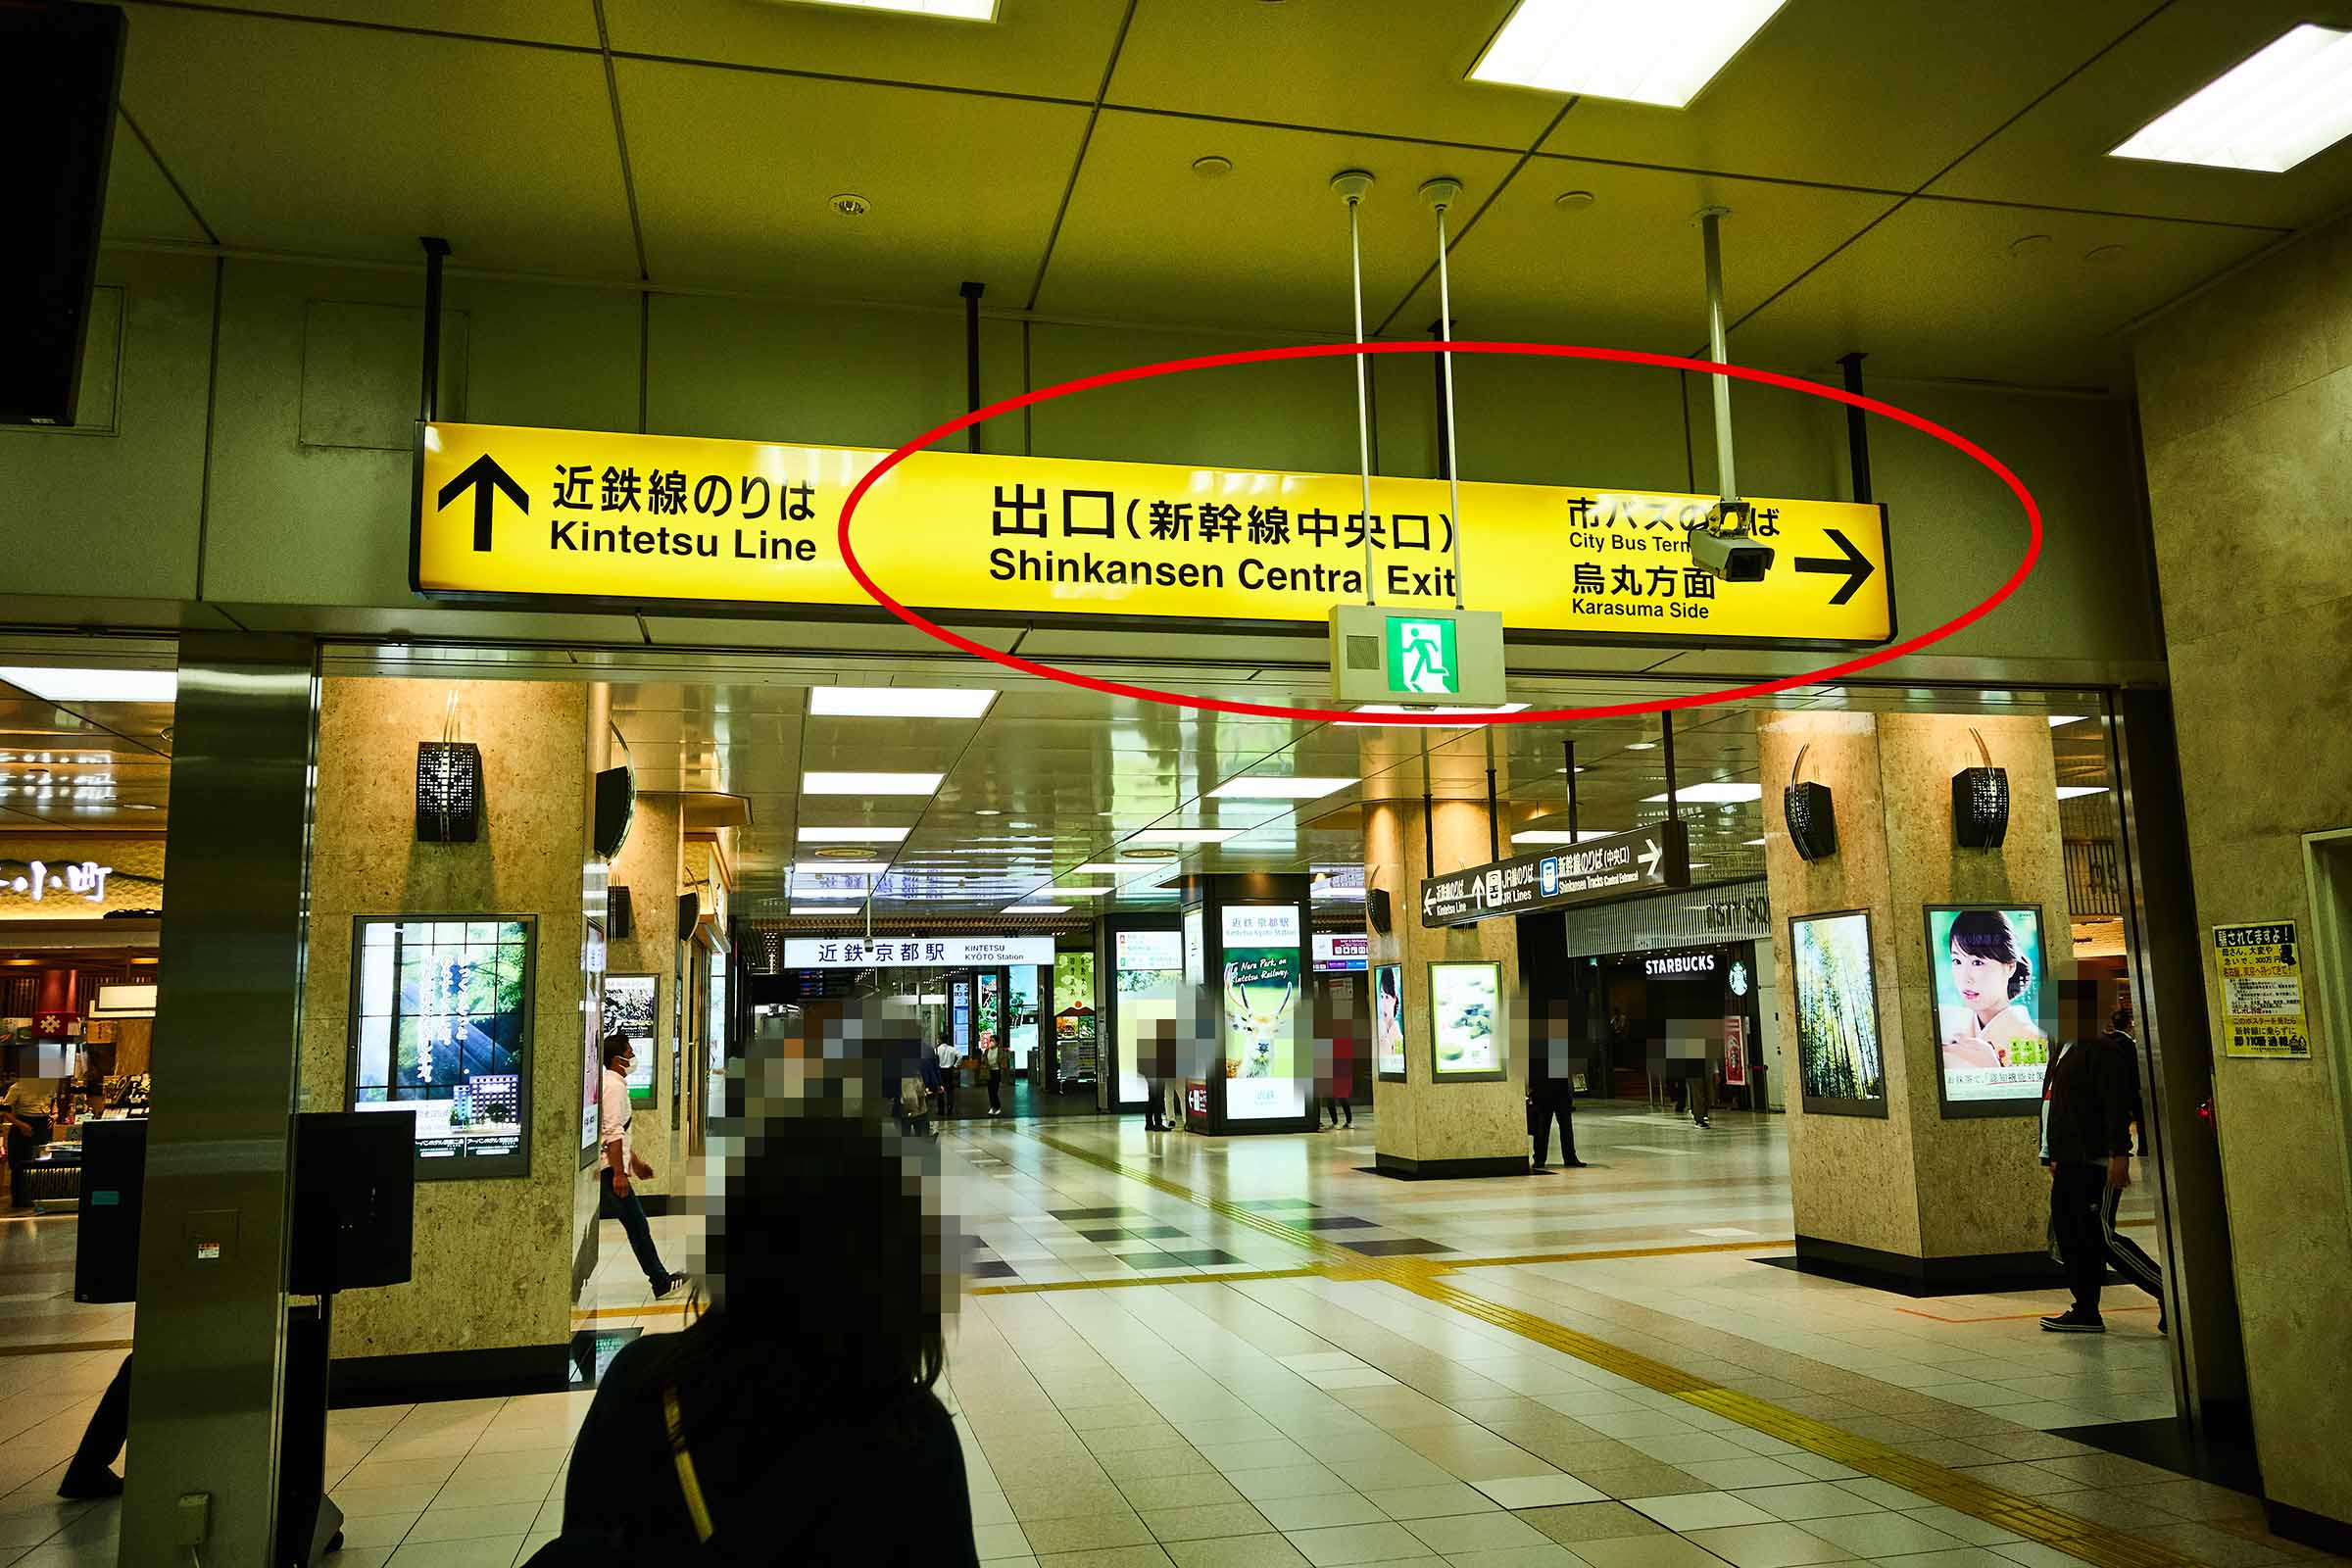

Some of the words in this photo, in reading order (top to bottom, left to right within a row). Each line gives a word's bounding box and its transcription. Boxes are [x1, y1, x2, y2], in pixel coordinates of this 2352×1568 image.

[1567, 496, 1781, 537] 市バスのば
[550, 520, 719, 558] Kintetsu
[734, 528, 817, 562] Line
[1569, 531, 1604, 554] City
[1611, 534, 1647, 553] Bus
[989, 548, 1224, 588] Shinkansen
[1238, 558, 1370, 595] Centra
[1387, 564, 1456, 597] Exit
[1572, 562, 1716, 600] 烏丸方面
[1571, 598, 1664, 617] Karasuma
[1669, 602, 1709, 619] Side
[0, 859, 113, 902] 小町
[1559, 878, 1588, 895] Shinkansen
[1587, 874, 1604, 890] Tracks
[1455, 900, 1467, 913] Line
[1501, 893, 1513, 906] JR
[1513, 889, 1532, 904] Lines
[817, 943, 945, 963] 近鉄京都駅
[964, 944, 1005, 953] KINTETSU
[997, 953, 1024, 961] Station
[1645, 955, 1715, 975] STARBUCKS
